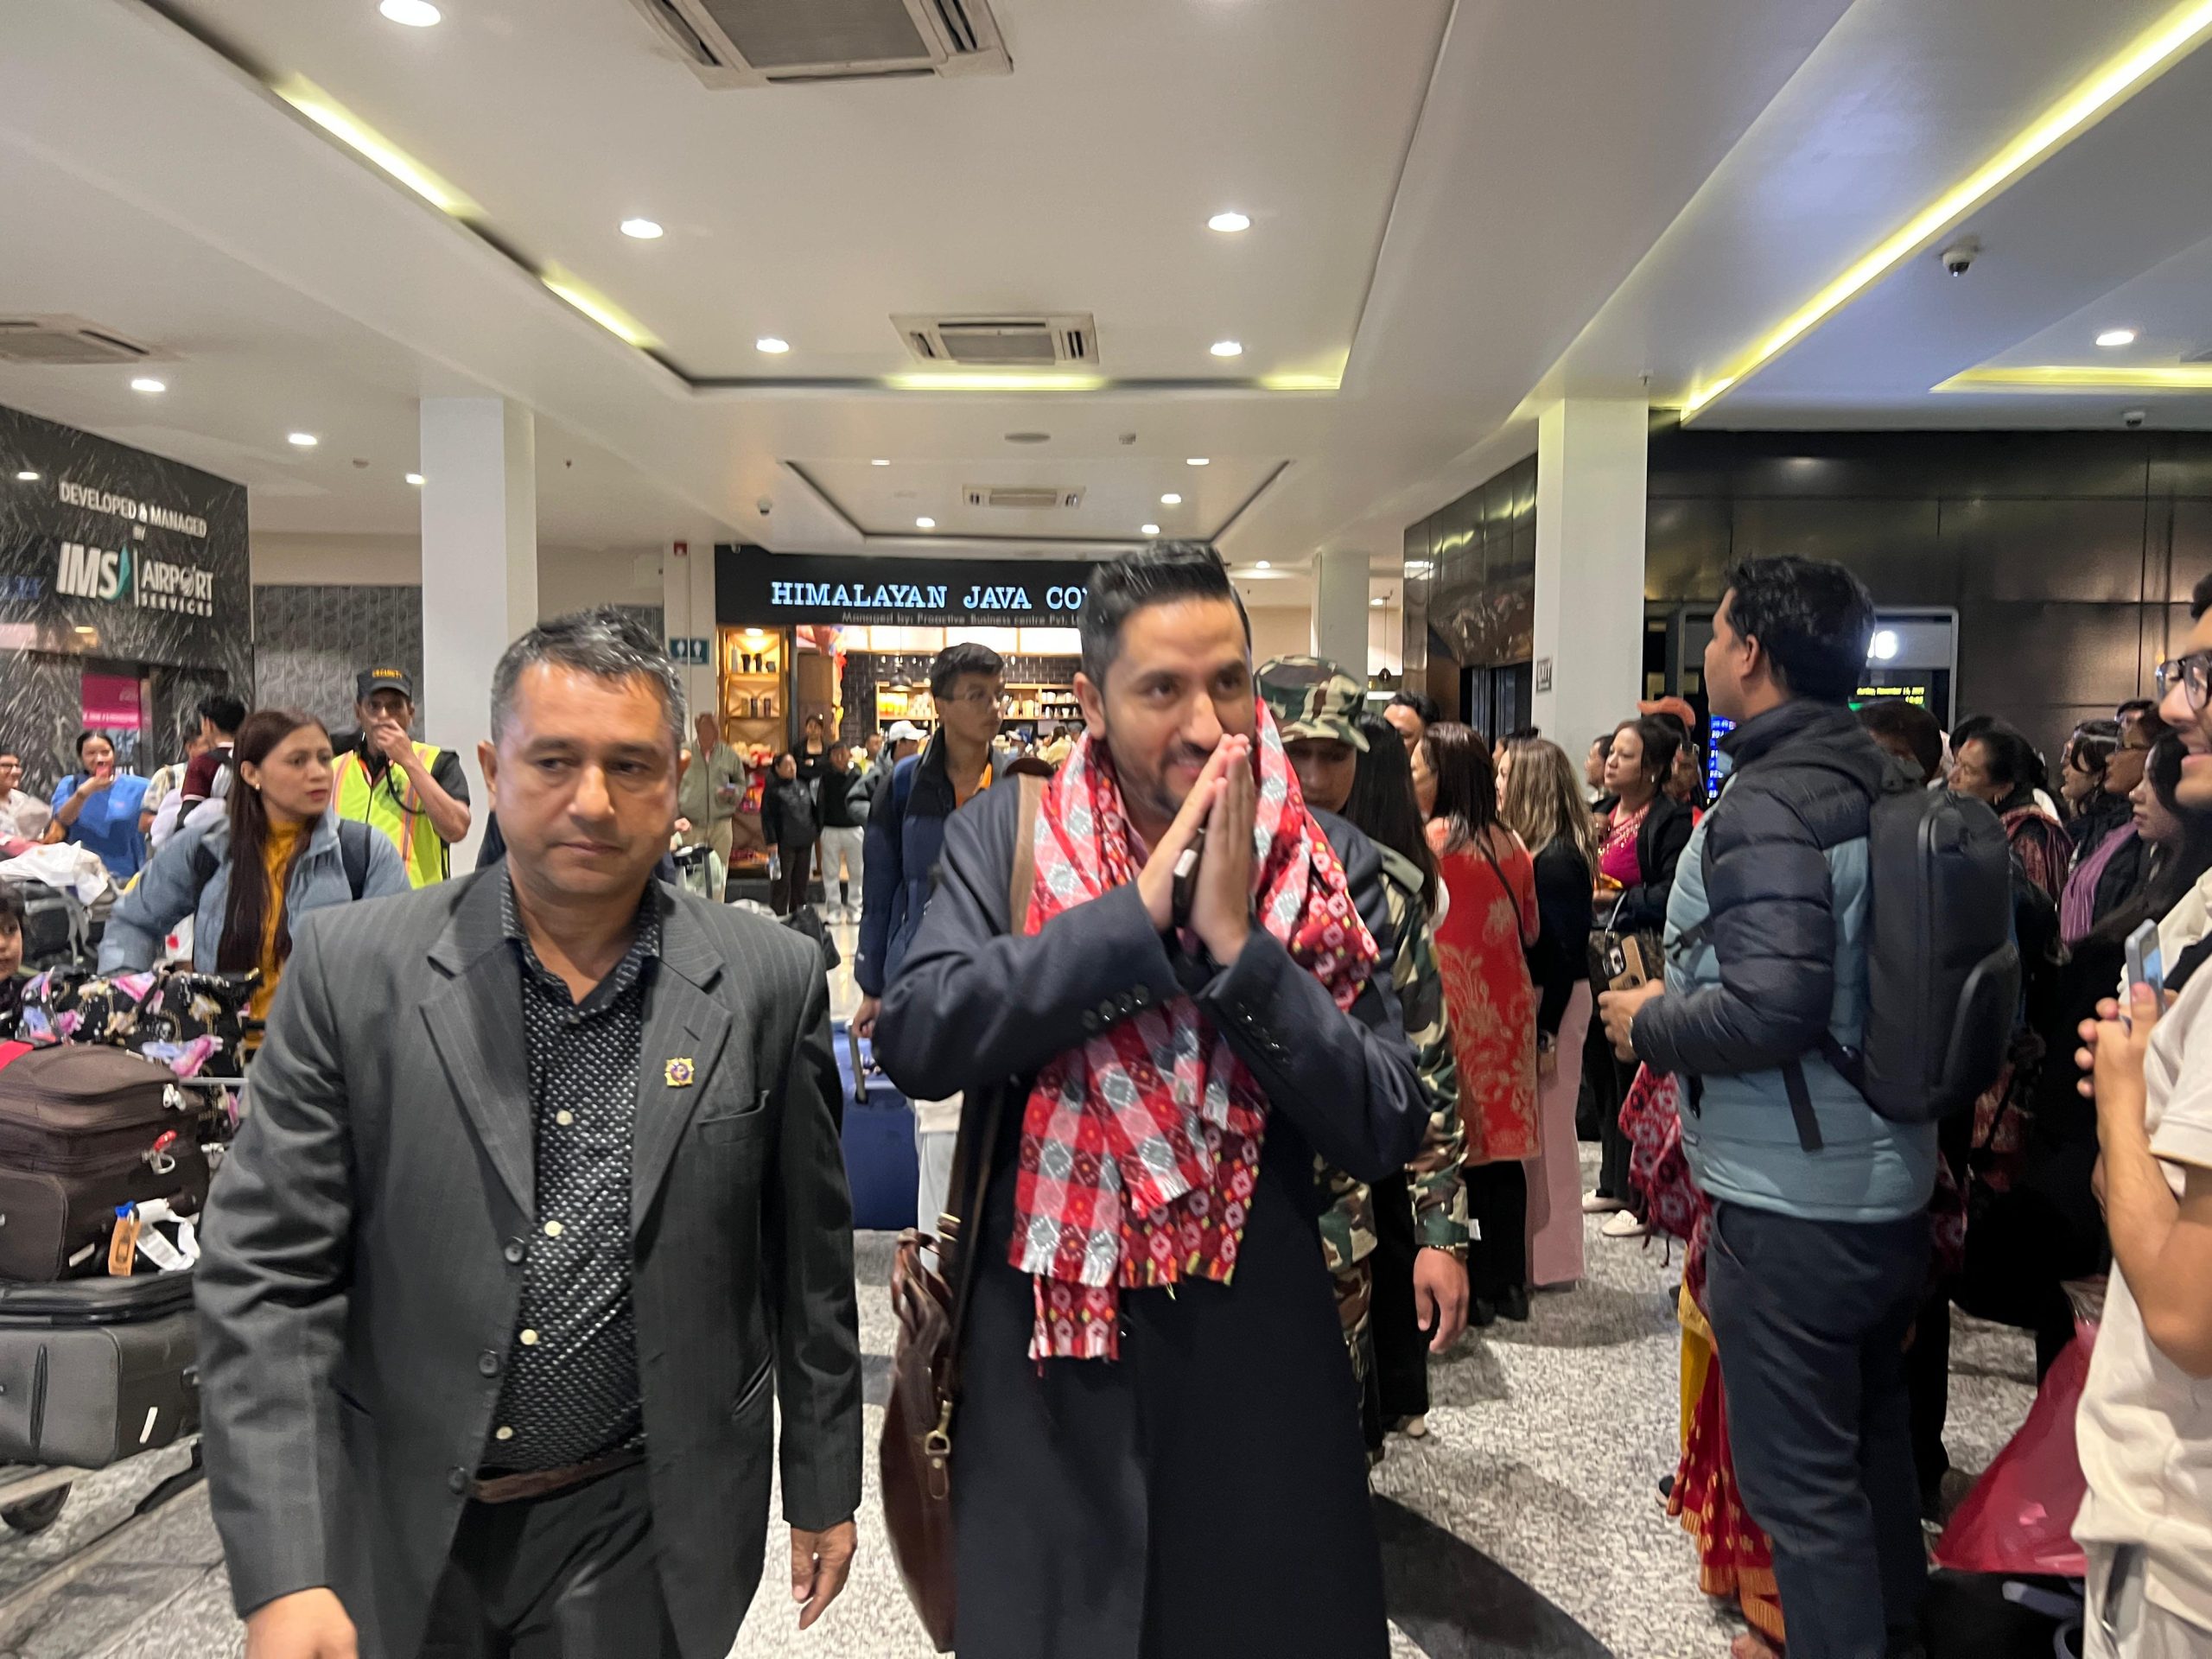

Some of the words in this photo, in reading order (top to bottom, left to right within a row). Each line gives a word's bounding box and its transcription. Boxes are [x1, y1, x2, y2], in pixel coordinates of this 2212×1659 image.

[60, 481, 137, 519] DEVELOPED
[138, 502, 148, 523] &
[149, 505, 207, 538] MANAGED
[56, 542, 120, 600] IMS
[141, 559, 214, 601] AIRPORT
[141, 592, 213, 617] SERVICES
[772, 582, 948, 608] HIMALAYAN
[963, 586, 1033, 609] JAVA
[1046, 586, 1087, 610] CO
[842, 611, 893, 624] Managed
[918, 612, 965, 624] Proactive
[970, 613, 1011, 625] Business
